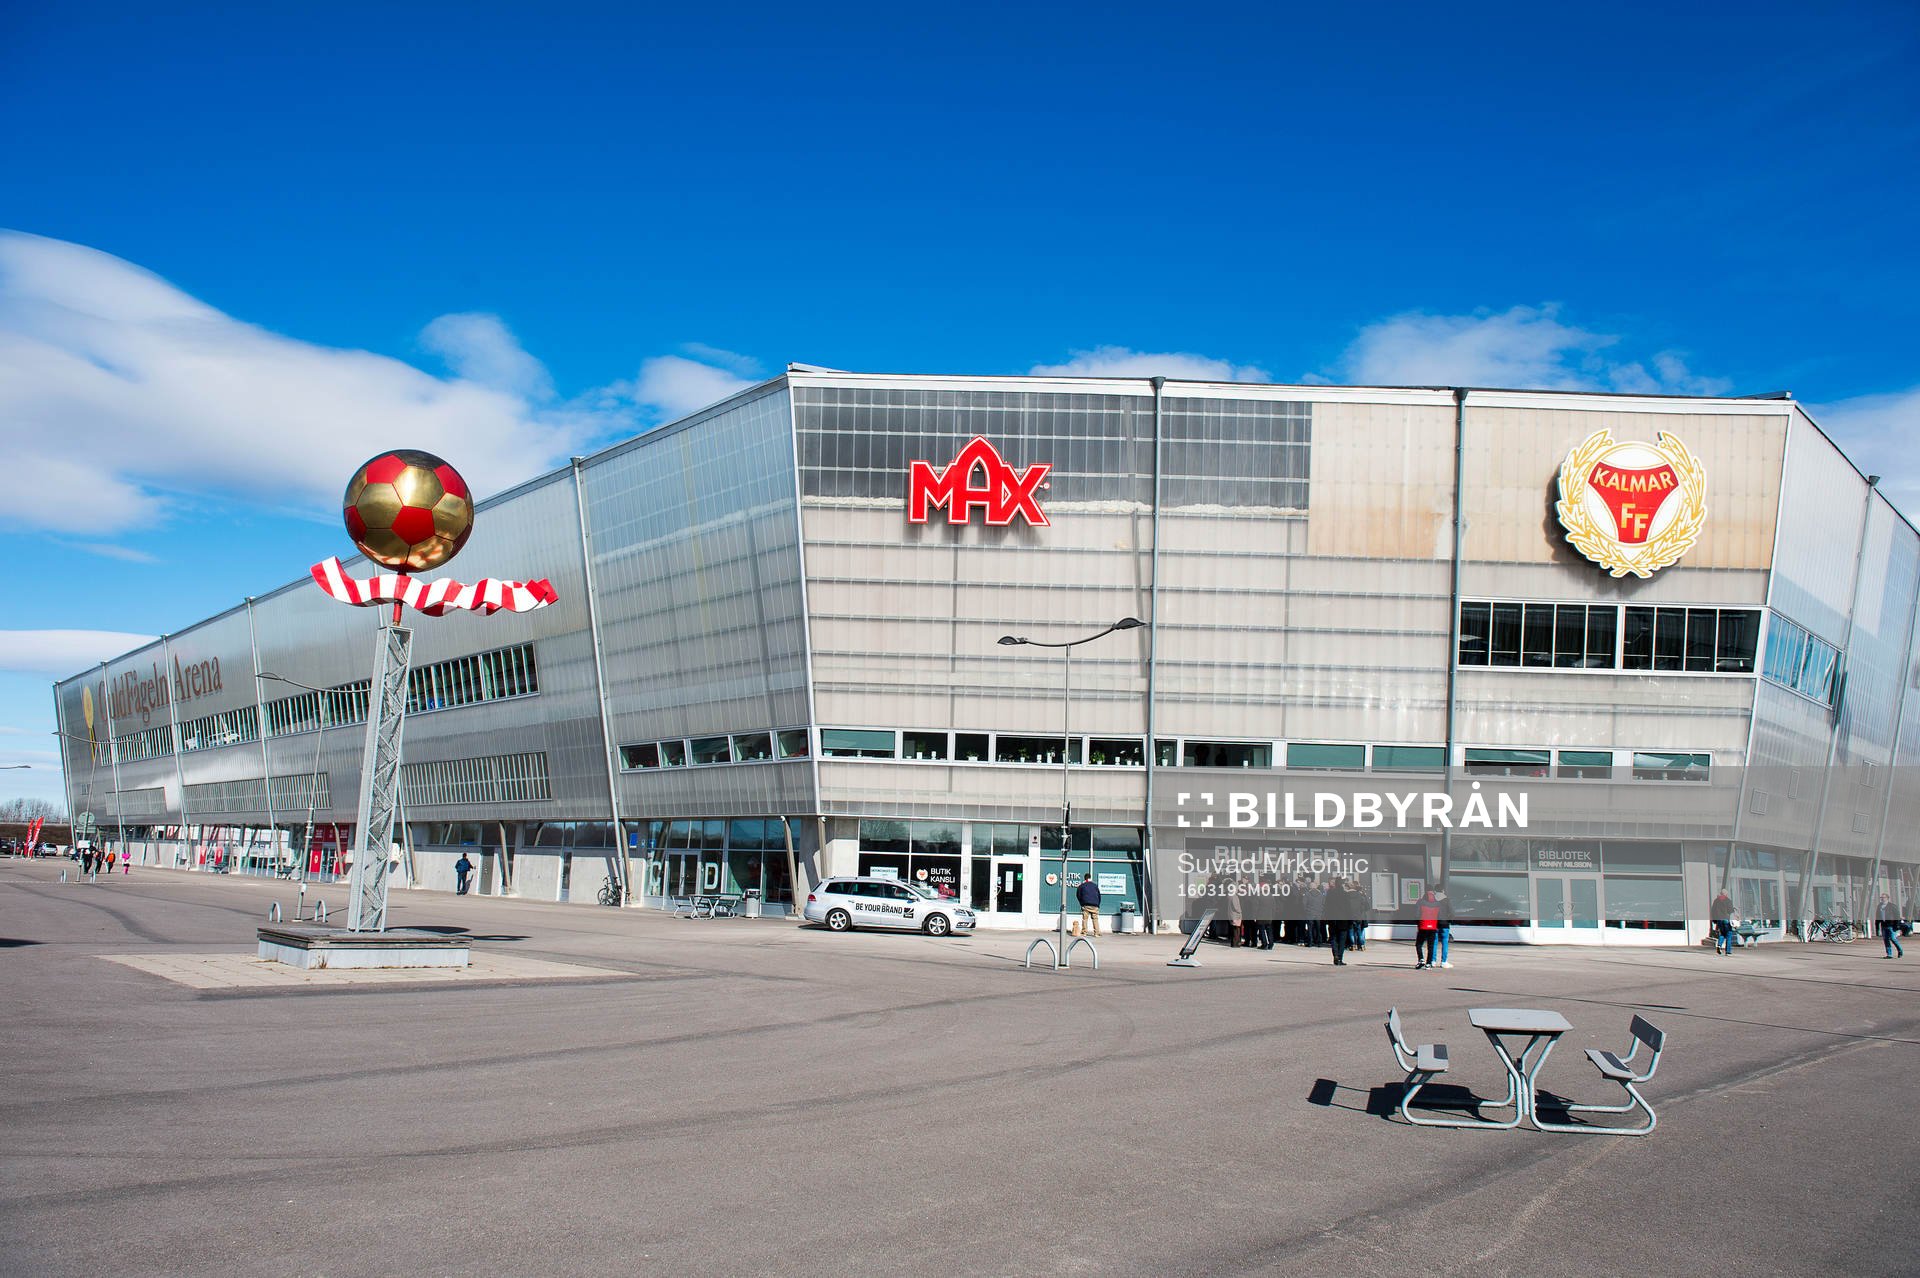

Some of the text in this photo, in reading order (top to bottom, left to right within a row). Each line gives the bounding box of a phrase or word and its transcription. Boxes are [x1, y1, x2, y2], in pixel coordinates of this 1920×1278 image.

[908, 435, 1052, 527] MAX
[1594, 468, 1674, 493] KALMAR
[1621, 503, 1649, 538] FF
[175, 653, 223, 702] Arena
[1215, 845, 1339, 867] BILJETTER
[1538, 850, 1591, 860] BIBLIOTEK
[704, 862, 718, 889] D
[855, 903, 902, 914] BE YOUR BRAND
